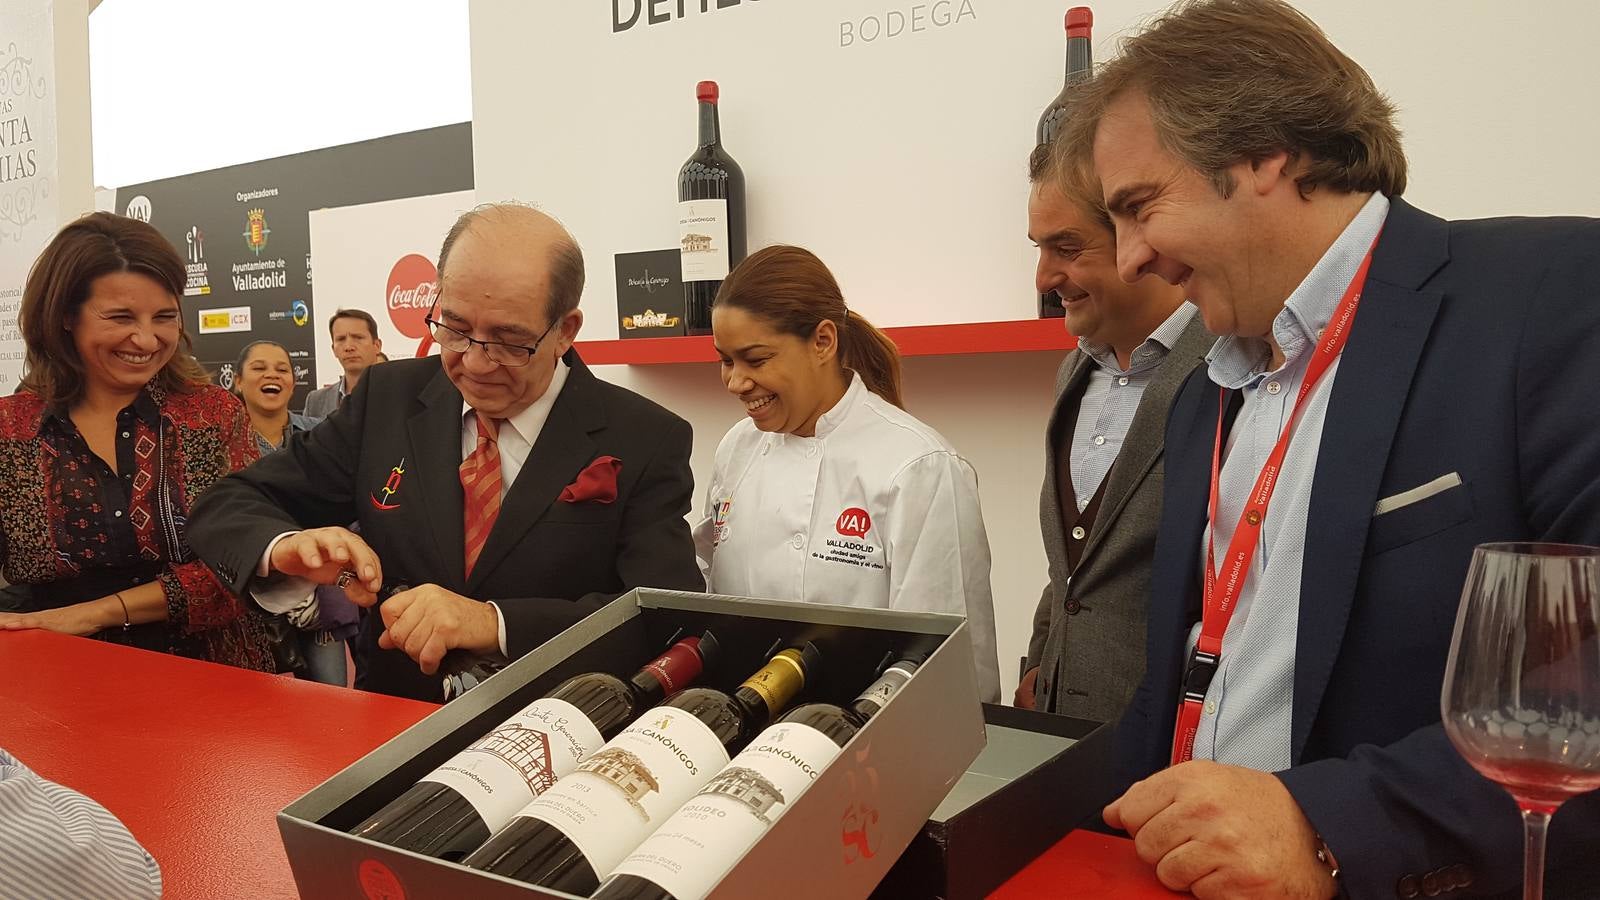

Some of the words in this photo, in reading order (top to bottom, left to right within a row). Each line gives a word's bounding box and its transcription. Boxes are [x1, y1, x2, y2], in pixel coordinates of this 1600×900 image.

[839, 0, 978, 47] BODEGA
[236, 187, 279, 202] Organizadores
[232, 259, 275, 274] Ayuntamiento
[276, 258, 286, 269] de
[232, 271, 286, 292] Valladolid
[1323, 292, 1361, 354] info.valladolid.es
[839, 514, 866, 532] VA!
[826, 539, 874, 553] VALLADOLID
[830, 549, 849, 557] ciudad
[849, 552, 866, 560] amiga
[1220, 551, 1245, 612] info.valladolid.es
[641, 728, 699, 776] CANÓNIGOS
[1183, 728, 1197, 761] alladolid
[757, 744, 819, 780] CANÓNIGO
[460, 768, 494, 795] CANÓNIGOS
